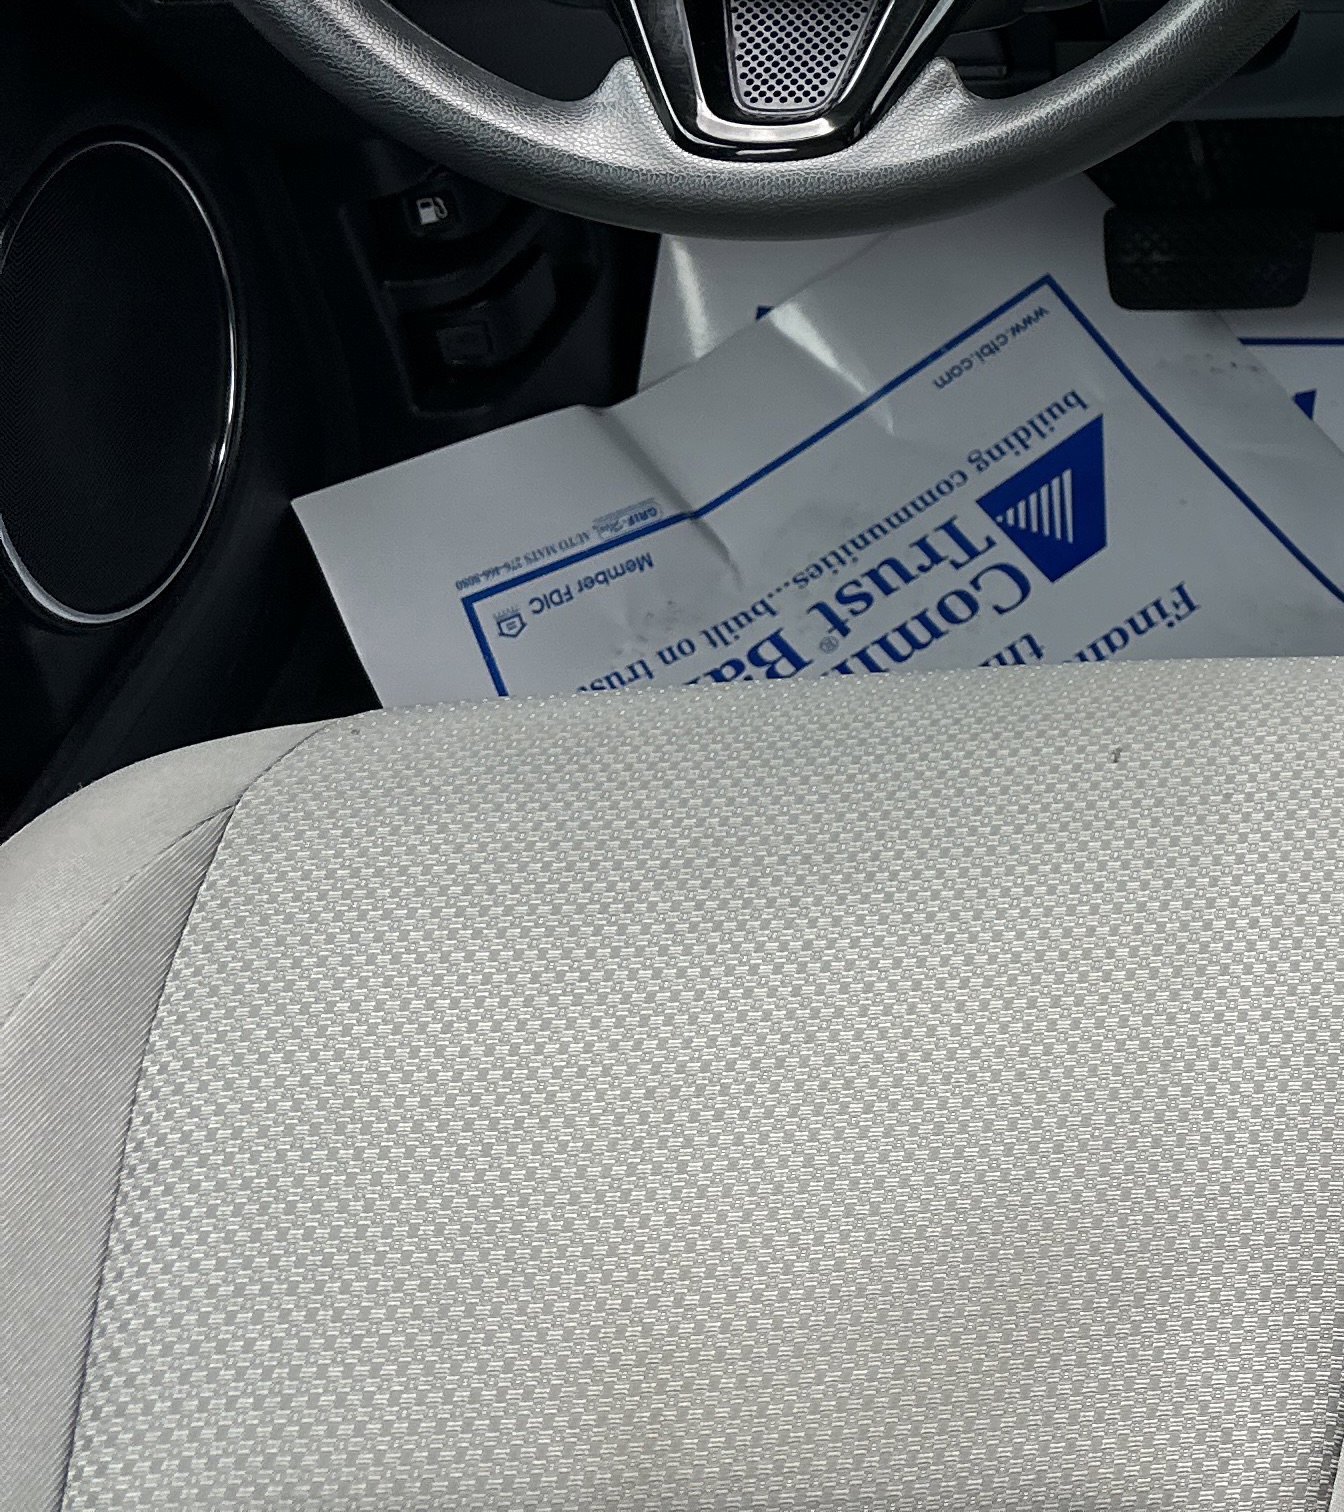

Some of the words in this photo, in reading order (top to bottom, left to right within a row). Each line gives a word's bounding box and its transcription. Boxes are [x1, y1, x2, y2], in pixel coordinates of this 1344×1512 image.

[932, 306, 1050, 390] www.ctbi.com
[967, 389, 1090, 474] building
[577, 551, 655, 594] Member
[528, 583, 575, 615] FDIC
[657, 637, 697, 667] on
[577, 658, 654, 692] trus
